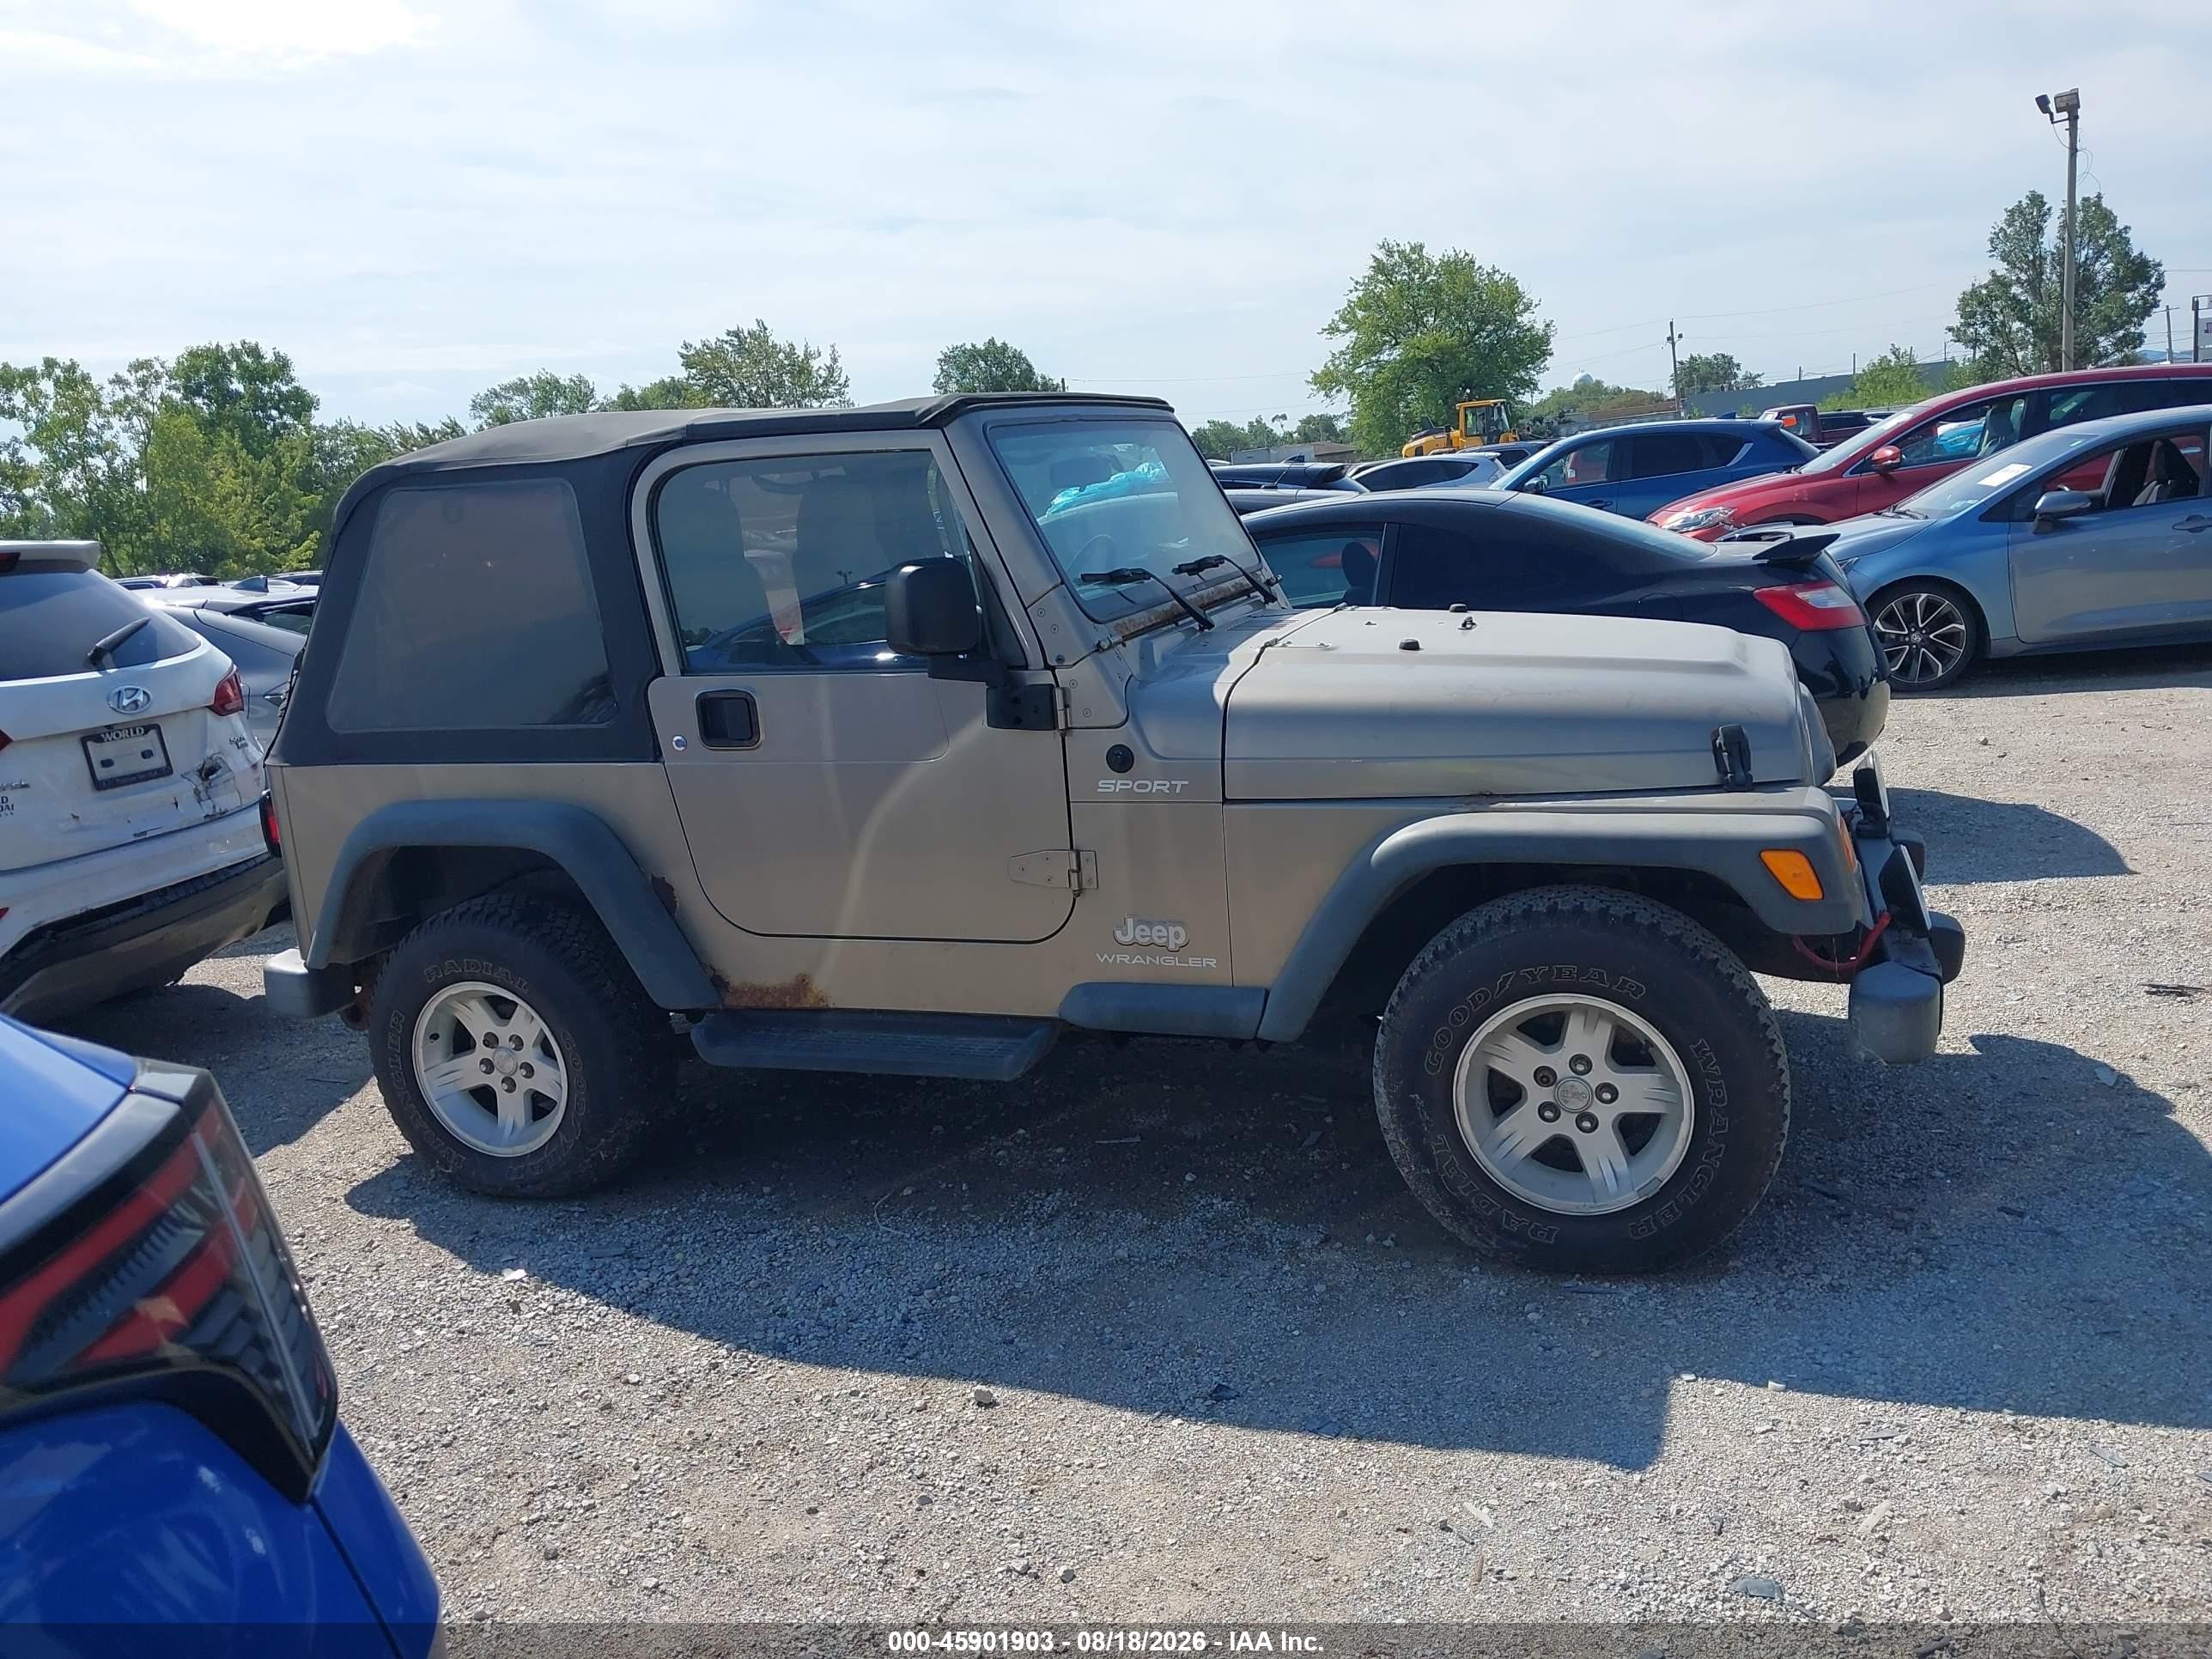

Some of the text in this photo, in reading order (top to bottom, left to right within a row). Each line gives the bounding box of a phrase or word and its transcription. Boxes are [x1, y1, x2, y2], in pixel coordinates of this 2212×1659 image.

[101, 726, 145, 742] WORLD
[1097, 780, 1189, 793] SPORT
[1115, 916, 1188, 950] Jeep
[423, 959, 529, 992] RADIAL
[1097, 953, 1217, 969] WRANGLER
[386, 1010, 468, 1172] WRANGLER
[1630, 1038, 1729, 1239] WRANGLER
[1431, 1135, 1559, 1243] RADIAL
